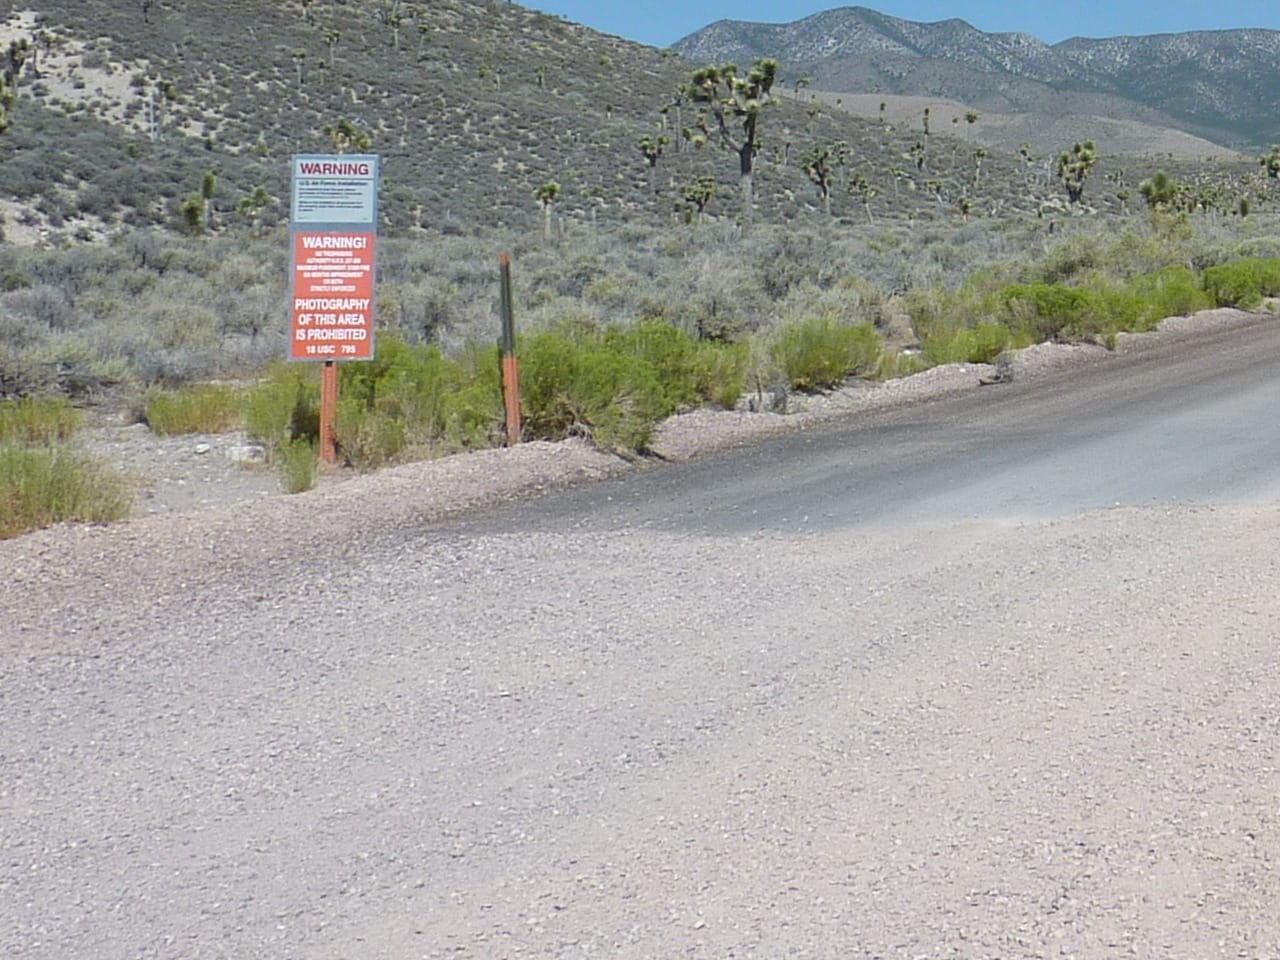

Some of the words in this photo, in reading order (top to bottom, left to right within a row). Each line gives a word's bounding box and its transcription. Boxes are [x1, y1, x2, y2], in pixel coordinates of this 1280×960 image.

[300, 163, 369, 175] WARNING
[302, 236, 366, 248] WARNING!
[295, 298, 370, 310] PHOTOGRAPHY
[298, 313, 313, 325] OF
[314, 313, 336, 325] THIS
[337, 313, 365, 325] AREA
[296, 328, 305, 341] IS
[307, 328, 367, 341] PROHIBITED
[306, 344, 316, 354] 18
[317, 344, 335, 354] USC
